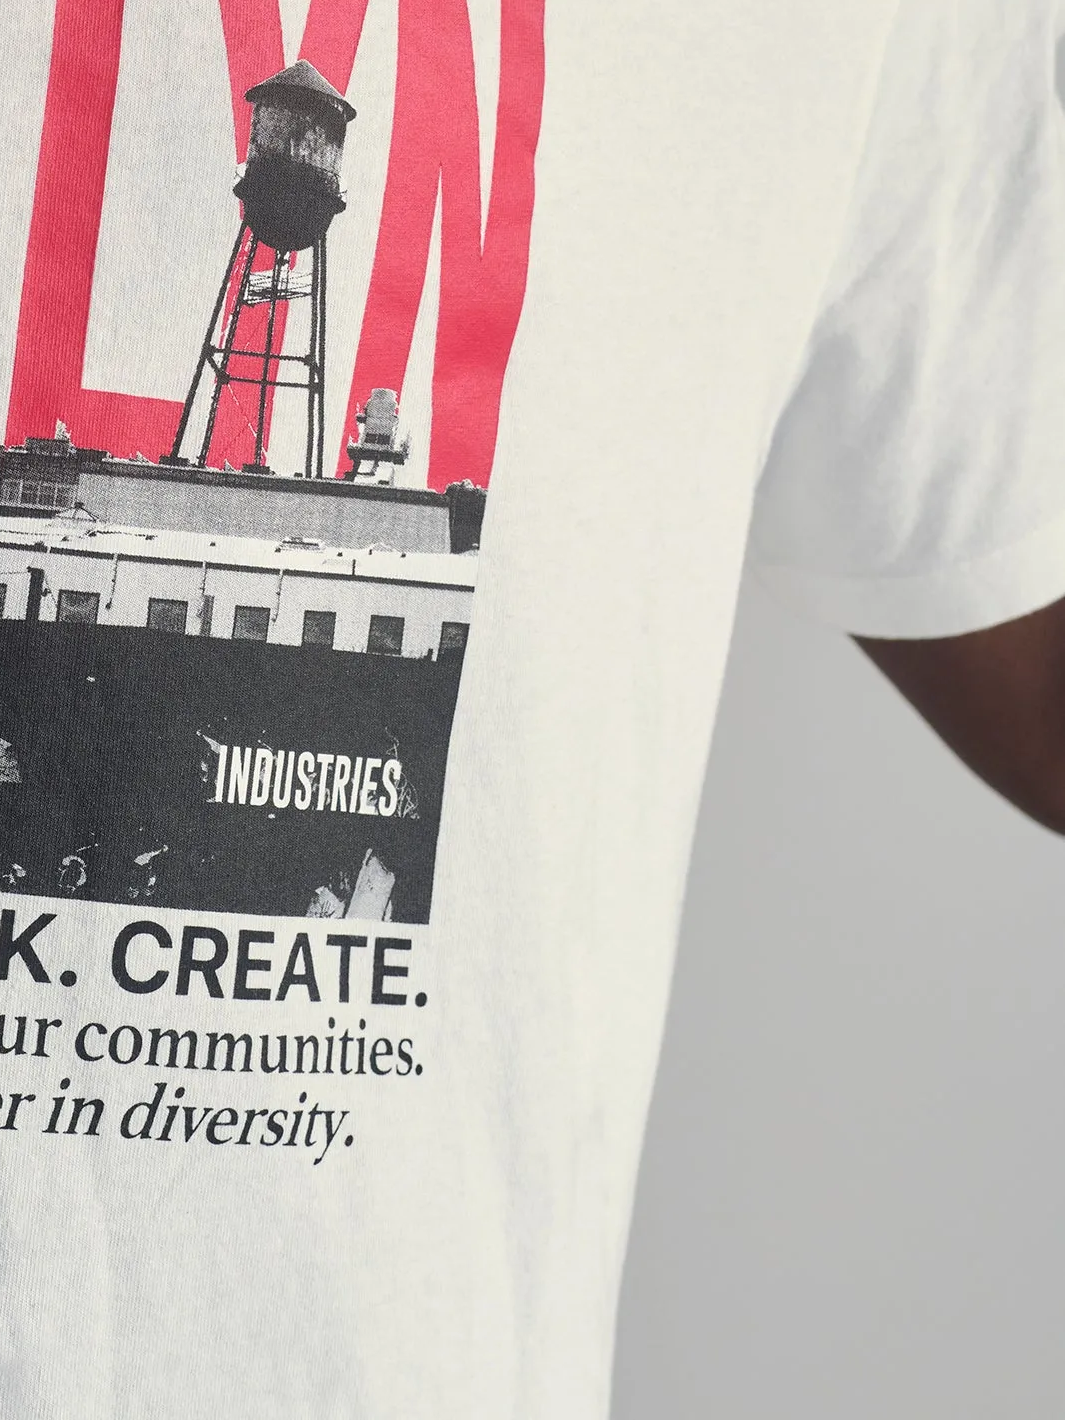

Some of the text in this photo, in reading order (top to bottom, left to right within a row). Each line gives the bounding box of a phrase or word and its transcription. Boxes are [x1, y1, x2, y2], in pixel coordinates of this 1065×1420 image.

[214, 743, 402, 818] INDUSTRIES
[111, 920, 428, 1008] CREATE.
[74, 1016, 424, 1077] communities.
[41, 1077, 105, 1137] in
[120, 1082, 356, 1166] diversity.
